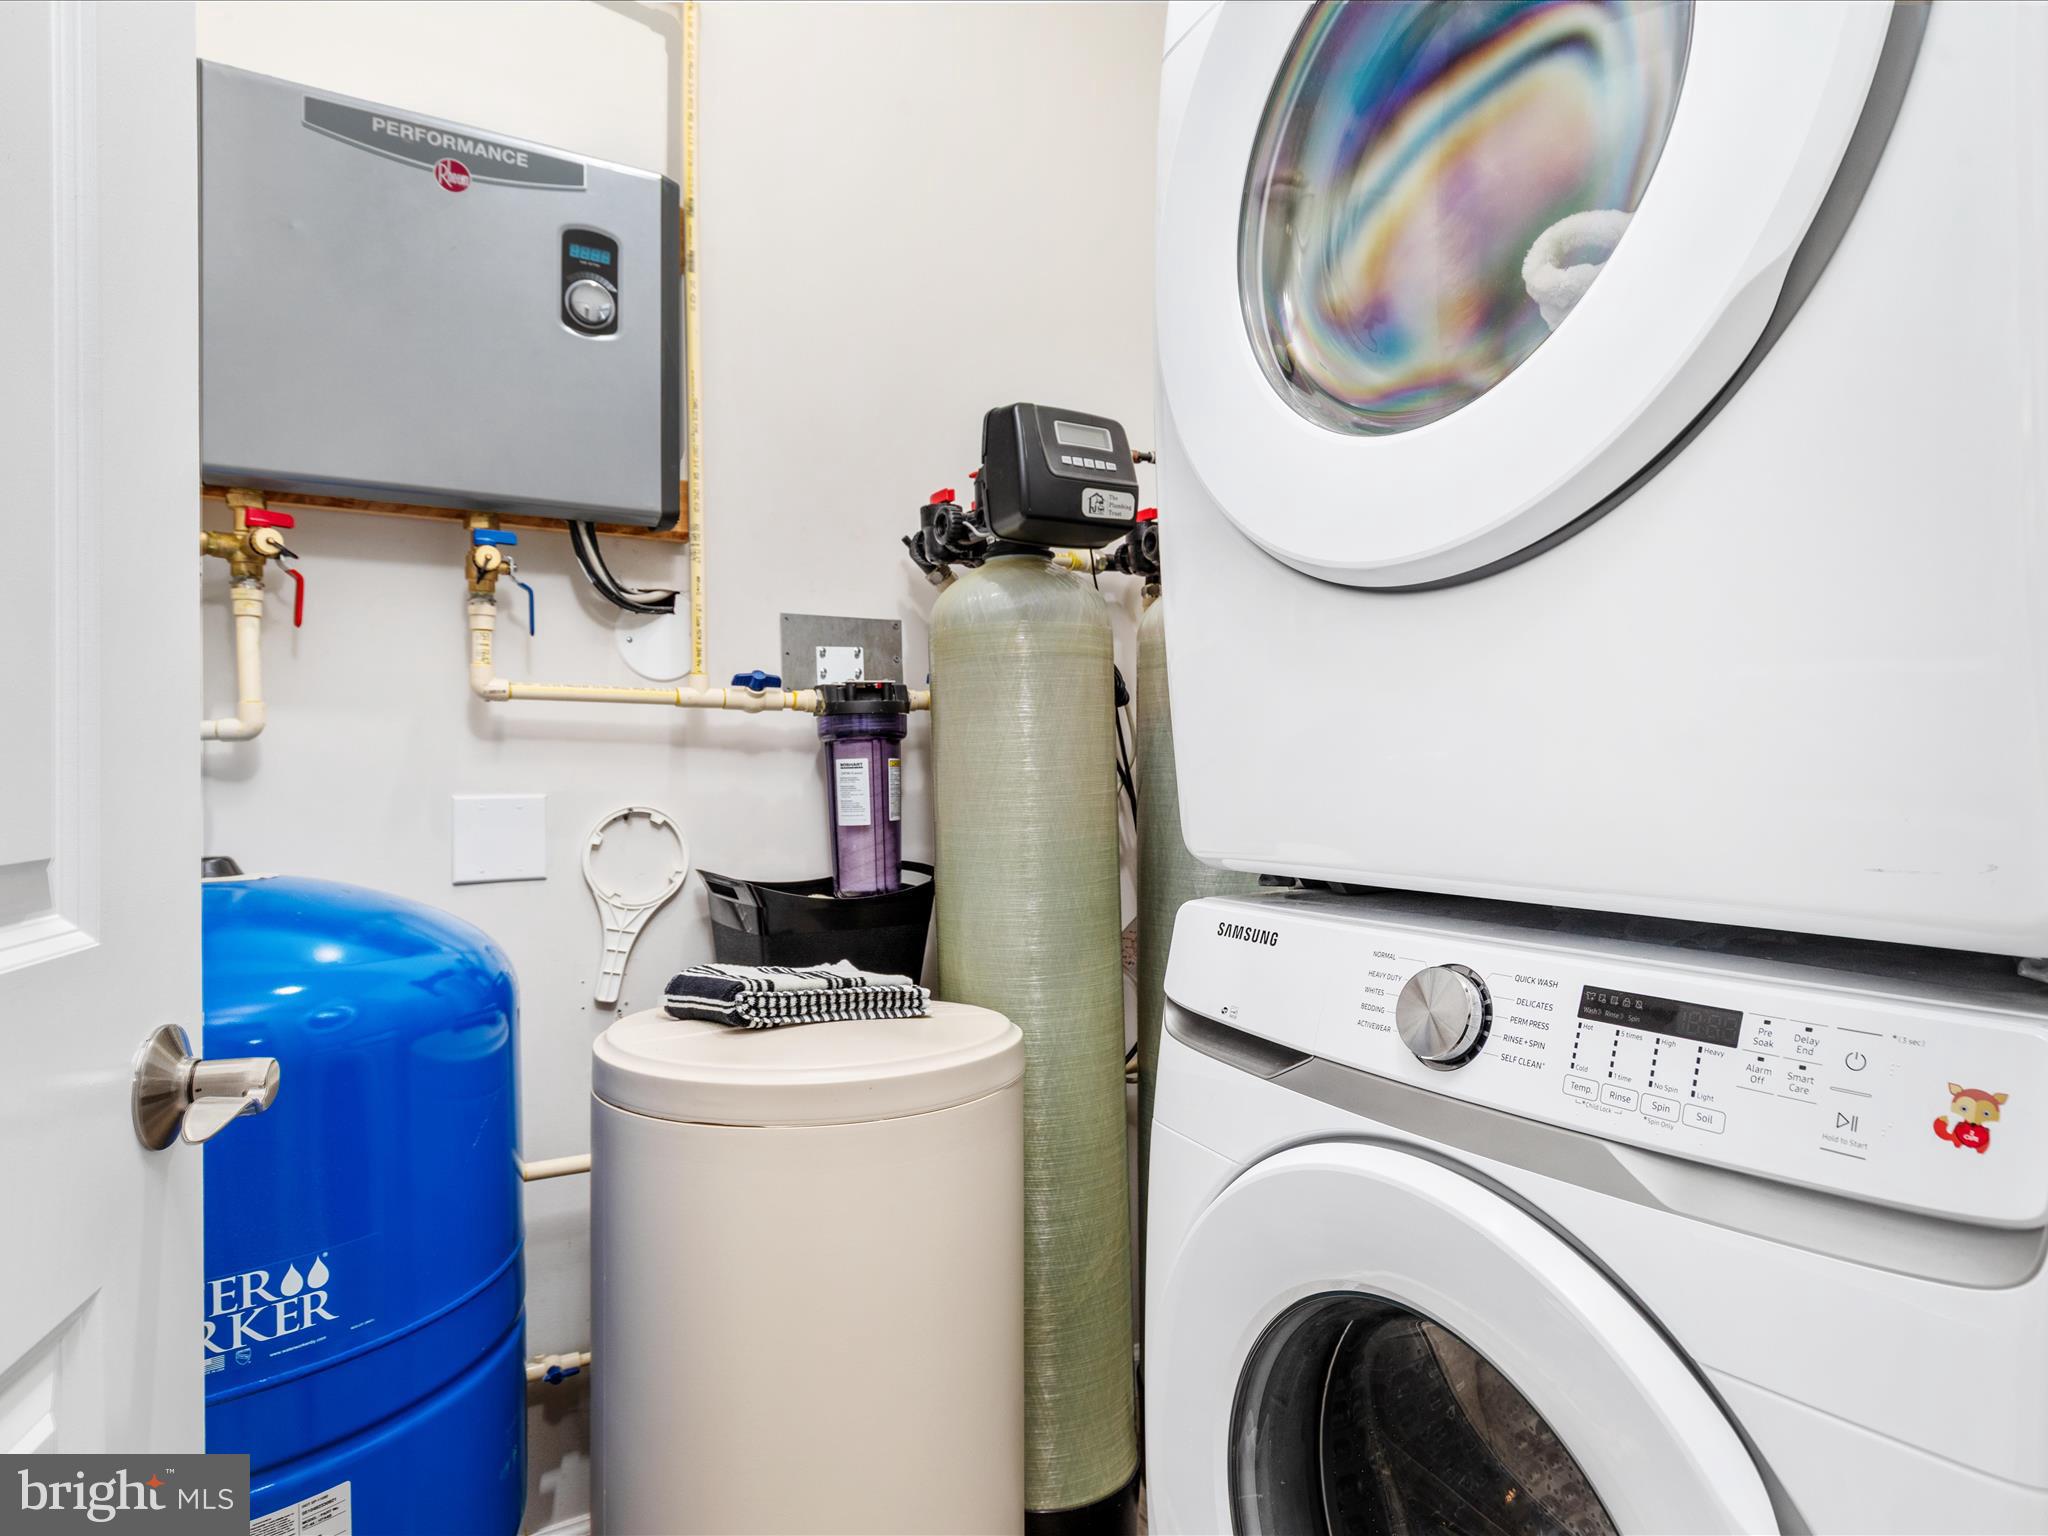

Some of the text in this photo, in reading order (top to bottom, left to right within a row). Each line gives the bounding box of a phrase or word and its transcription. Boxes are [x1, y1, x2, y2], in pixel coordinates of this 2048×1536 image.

[371, 116, 529, 168] PERFORMANCE
[1217, 922, 1279, 947] SAMSUNG
[1373, 951, 1396, 961] NORMAL
[1368, 970, 1402, 982] HEAVY DUTY
[1514, 974, 1559, 988] QUICK WASH
[1364, 986, 1385, 997] WHITES
[1360, 1002, 1385, 1014] BEDDING
[1516, 997, 1554, 1012] DELICATES
[1583, 1006, 1598, 1015] Wash
[1604, 1010, 1620, 1020] Rinse
[1357, 1019, 1392, 1033] ACTIVEWEAR
[1510, 1016, 1550, 1031] PERM PRESS
[1582, 1023, 1594, 1032] Hot
[1626, 1032, 1643, 1041] times
[1758, 1027, 1773, 1038] Pre
[1502, 1034, 1523, 1045] RINSE
[1528, 1040, 1546, 1050] SPIN
[1661, 1038, 1677, 1048] High
[1752, 1037, 1774, 1049] Soak
[1794, 1034, 1820, 1048] Delay
[1704, 1047, 1725, 1058] Heavy
[1796, 1046, 1814, 1056] End
[1500, 1053, 1518, 1063] SELF
[1575, 1064, 1589, 1073] Cold
[1746, 1064, 1773, 1077] Alarm
[1618, 1074, 1632, 1083] time
[1750, 1074, 1766, 1086] Off
[1787, 1072, 1816, 1086] Smart
[1570, 1080, 1593, 1096] Temp.
[1654, 1082, 1679, 1094] No Spin
[1788, 1084, 1810, 1096] Care
[1609, 1090, 1632, 1104] Rinse
[1696, 1092, 1714, 1103] Light
[1651, 1100, 1671, 1116] Spin
[1696, 1112, 1714, 1124] Soil
[1822, 1132, 1868, 1151] Hold to Start
